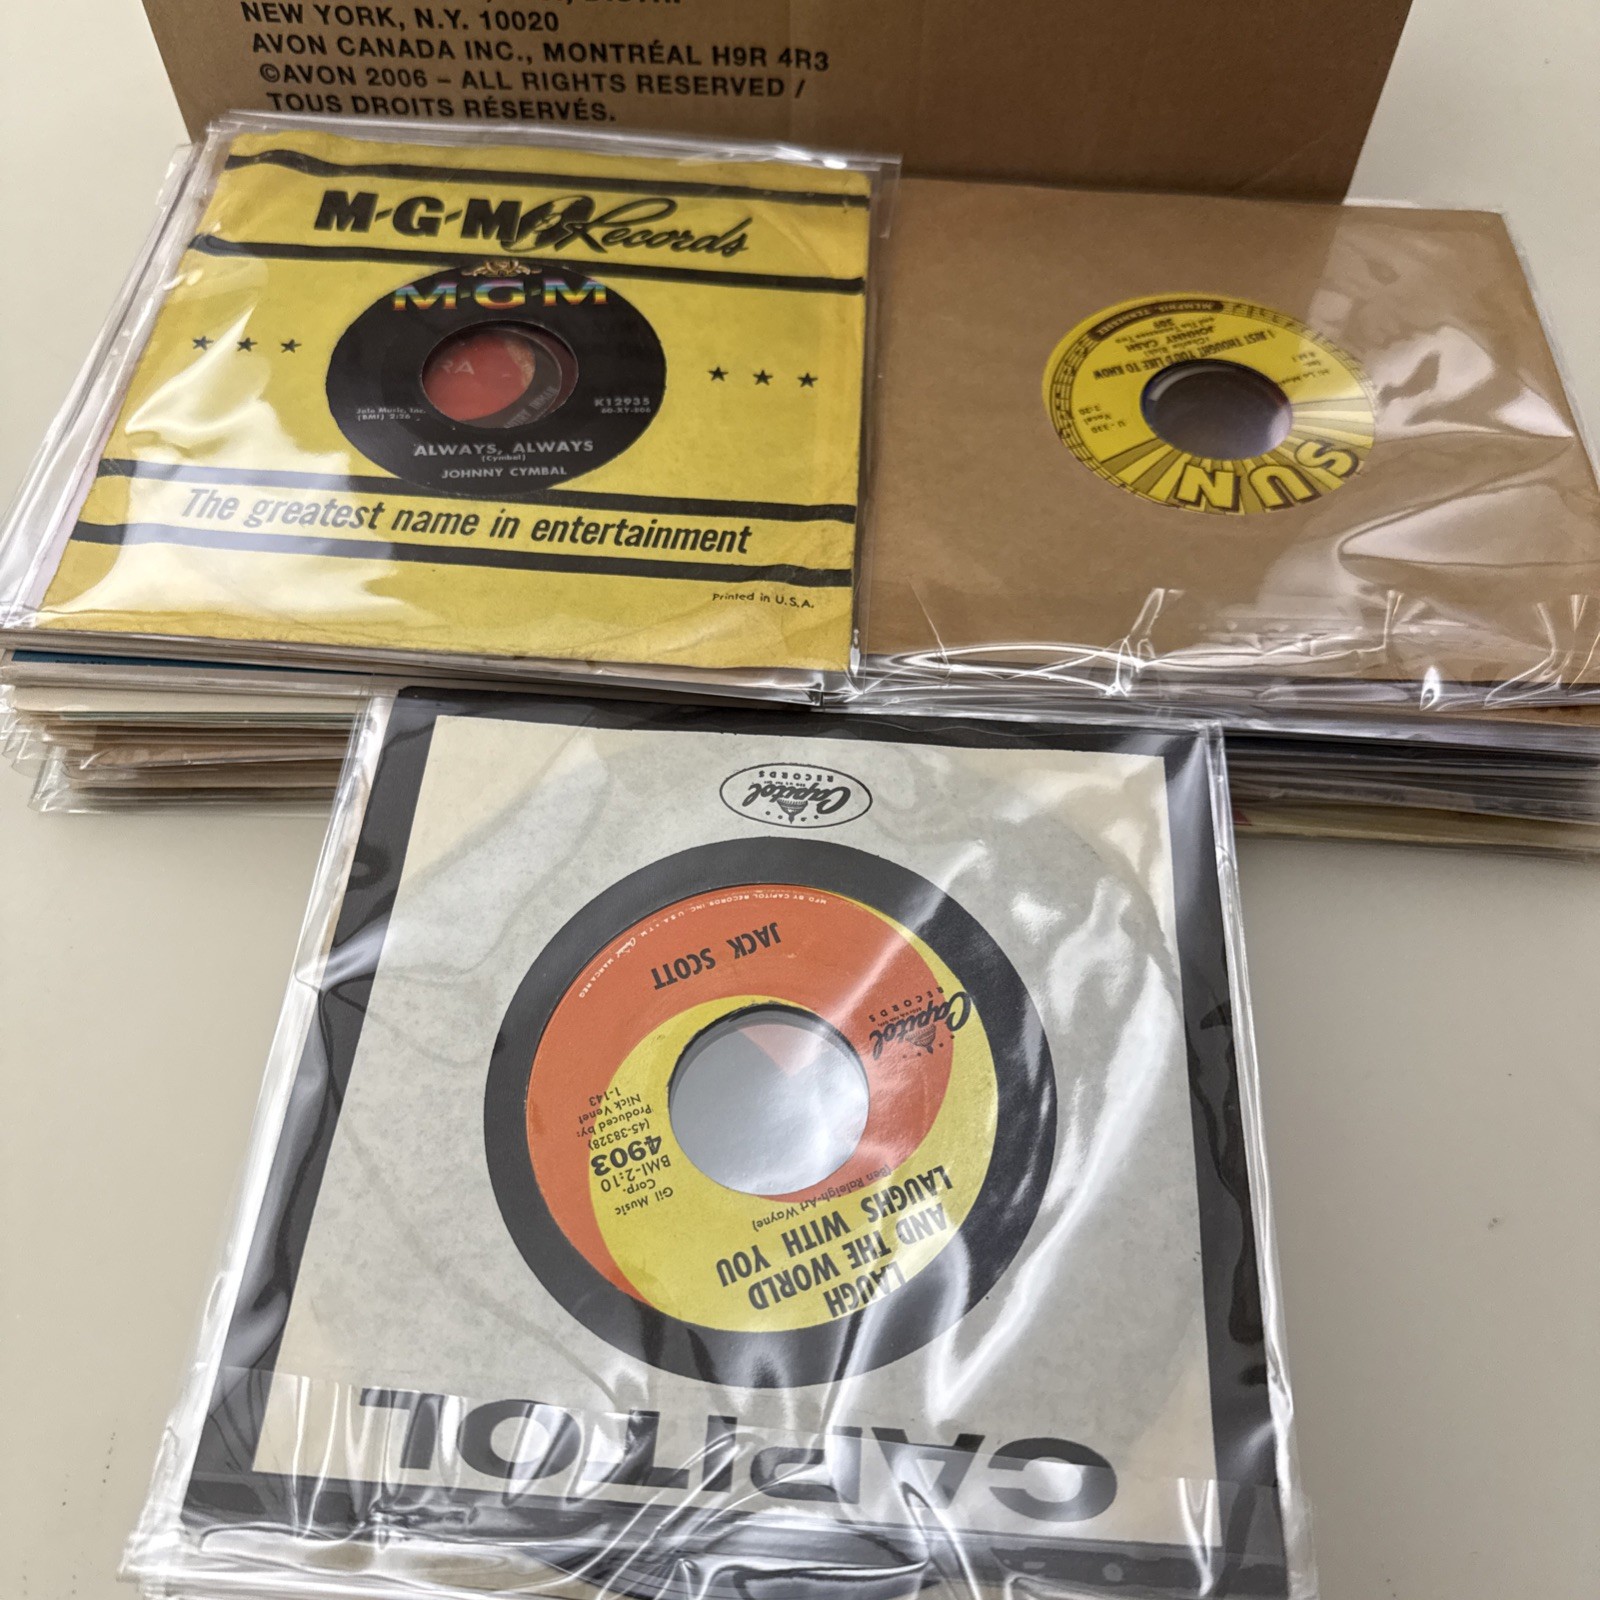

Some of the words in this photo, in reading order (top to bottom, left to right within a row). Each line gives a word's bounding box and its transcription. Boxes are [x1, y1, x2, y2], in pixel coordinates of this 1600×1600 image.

[240, 1, 304, 24] NEW
[313, 4, 406, 32] YORK,
[414, 8, 469, 30] N.Y.
[479, 10, 560, 32] 10020
[252, 33, 327, 56] AVON
[337, 36, 455, 60] CANADA
[465, 41, 533, 65] INC.,
[543, 39, 701, 66] MONTRÉAL
[712, 45, 768, 67] H9R
[778, 47, 830, 72] 4R3
[366, 68, 428, 88] 2006
[461, 71, 513, 90] ALL
[522, 71, 626, 93] RIGHTS
[637, 74, 785, 97] RESERVED
[267, 92, 343, 113] TOUS
[352, 96, 454, 117] DROITS
[465, 95, 616, 122] RÉSERVÉS.
[555, 198, 753, 257] Records
[1093, 365, 1125, 380] KNOW
[594, 397, 650, 407] K12935
[413, 443, 504, 458] ALWAYS,
[513, 440, 594, 454] ALWAYS
[481, 453, 526, 463] (Cymbal)
[441, 468, 504, 479] JOHNNY
[509, 466, 567, 477] CYMBAL
[1176, 439, 1362, 513] SUN
[182, 489, 240, 520] The
[243, 499, 385, 529] greatest
[391, 508, 481, 536] name
[490, 509, 521, 539] in
[531, 516, 752, 554] entertainment
[712, 592, 755, 602] Printed
[759, 591, 771, 603] in
[775, 595, 815, 608] U.S.A.
[758, 770, 834, 783] RECORDS
[742, 781, 851, 815] Capitol
[753, 892, 791, 900] CAPITOL
[809, 895, 828, 905] MFD
[726, 922, 782, 960] JACK
[650, 947, 717, 991] SCOTT
[868, 986, 945, 1023] RECORDS
[869, 991, 972, 1061] Capitol
[588, 1086, 622, 1107] 1-143
[613, 1093, 642, 1110] Nick
[578, 1105, 613, 1125] Venet
[598, 1104, 653, 1132] Produced
[576, 1126, 597, 1138] by:
[588, 1117, 650, 1151] (45-38328)
[590, 1135, 662, 1177] 4903
[600, 1154, 671, 1193] BMI-2:10
[622, 1178, 656, 1195] Corp.
[866, 1163, 893, 1182] (Ben
[614, 1195, 650, 1216] Music
[654, 1186, 674, 1202] Gil
[799, 1176, 865, 1212] Raleigh-Art
[860, 1164, 954, 1223] LAUGHS
[752, 1206, 800, 1233] Wayne)
[780, 1210, 851, 1258] WITH
[895, 1203, 949, 1246] AND
[841, 1230, 893, 1270] THE
[715, 1244, 771, 1288] YOU
[748, 1252, 842, 1311] WORLD
[822, 1260, 906, 1318] LAUGH
[359, 1387, 1118, 1524] CAPITOL
